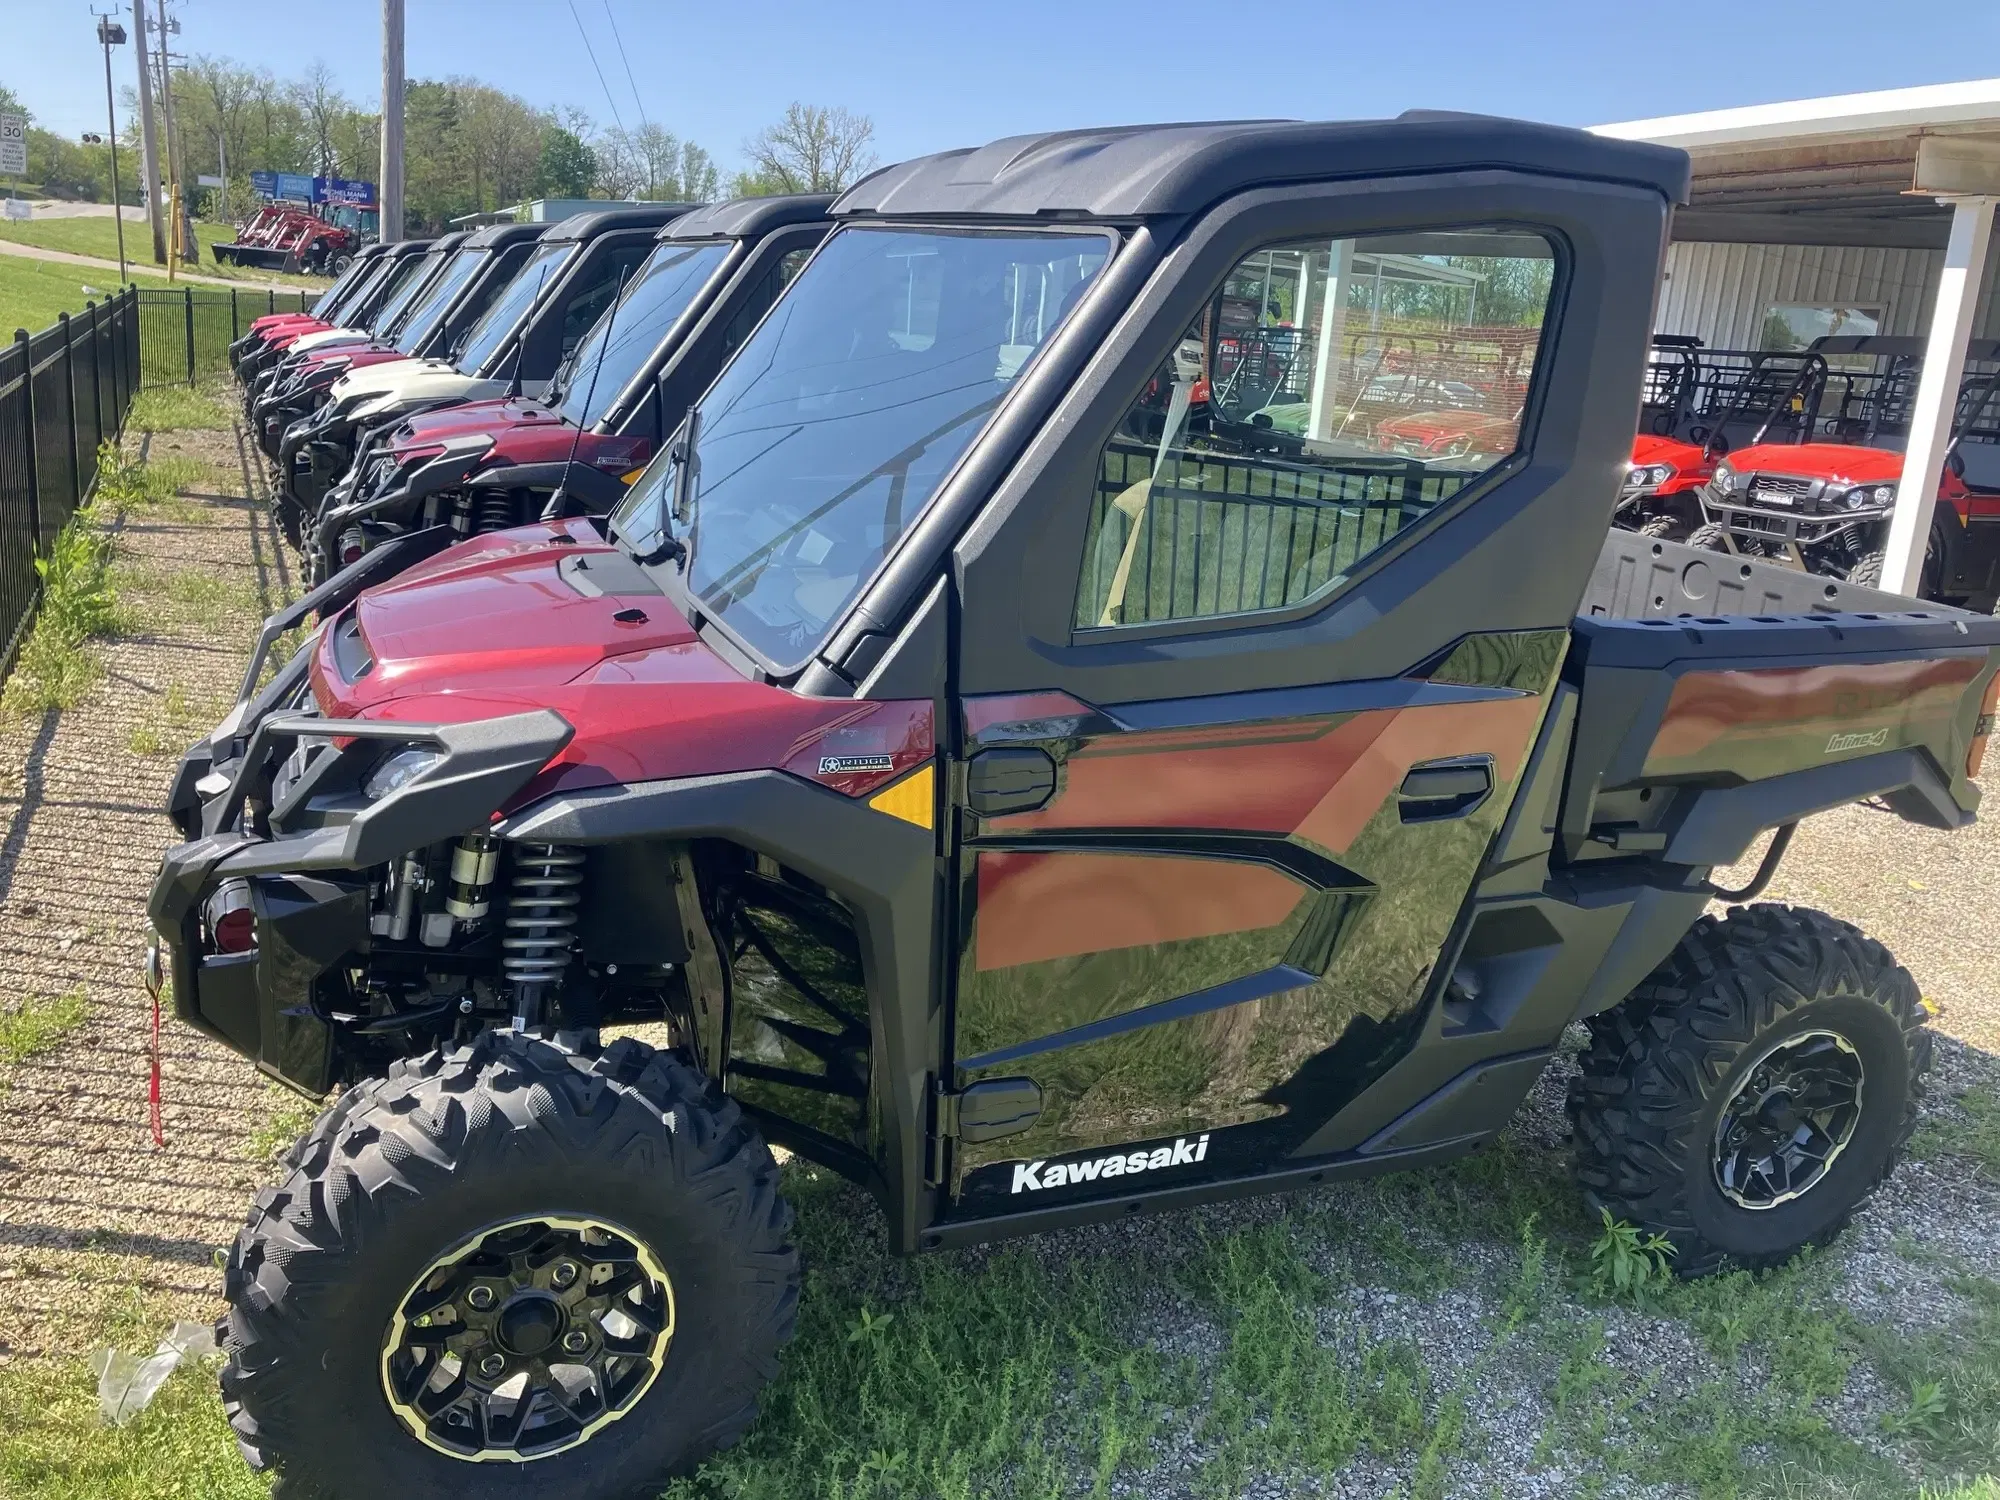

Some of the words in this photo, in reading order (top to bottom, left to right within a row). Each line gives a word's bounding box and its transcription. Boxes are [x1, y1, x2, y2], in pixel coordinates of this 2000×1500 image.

[3, 126, 21, 138] 30
[1756, 491, 1794, 506] Kawasaki
[842, 758, 888, 766] RIDGE
[1011, 1134, 1210, 1194] Kawasaki
